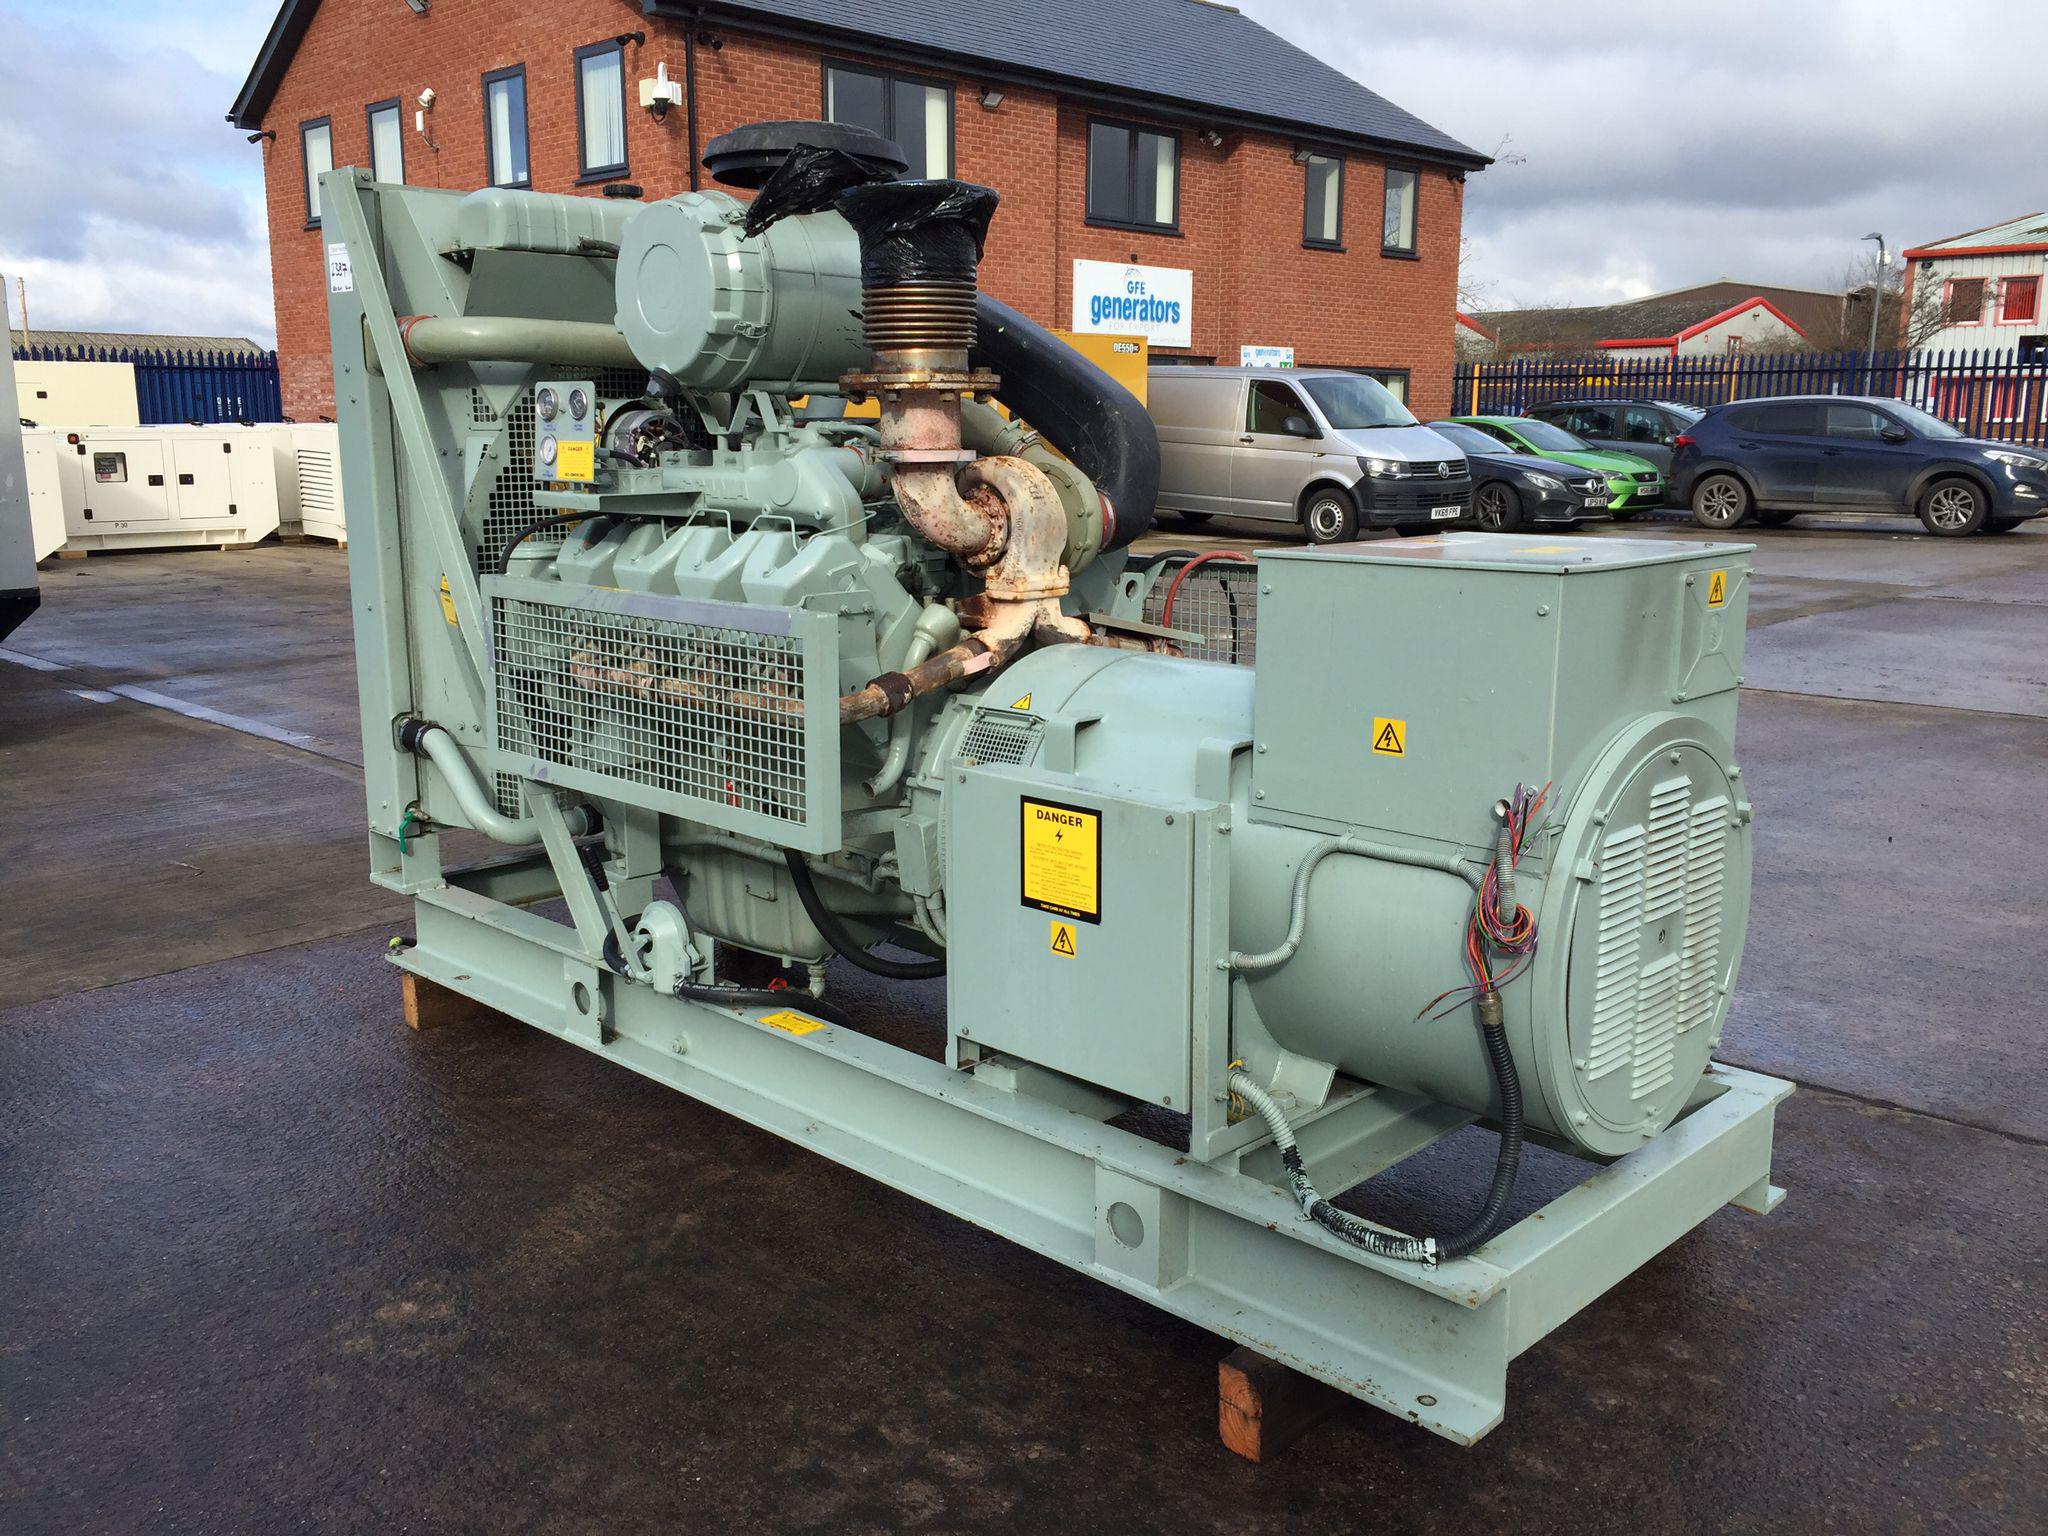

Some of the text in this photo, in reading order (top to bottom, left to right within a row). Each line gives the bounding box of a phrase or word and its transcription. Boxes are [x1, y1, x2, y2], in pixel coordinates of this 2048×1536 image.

[1127, 280, 1146, 295] GFE
[1091, 294, 1180, 325] generators
[1109, 321, 1161, 333] FOR EXPORT
[1036, 809, 1083, 828] DANGER
